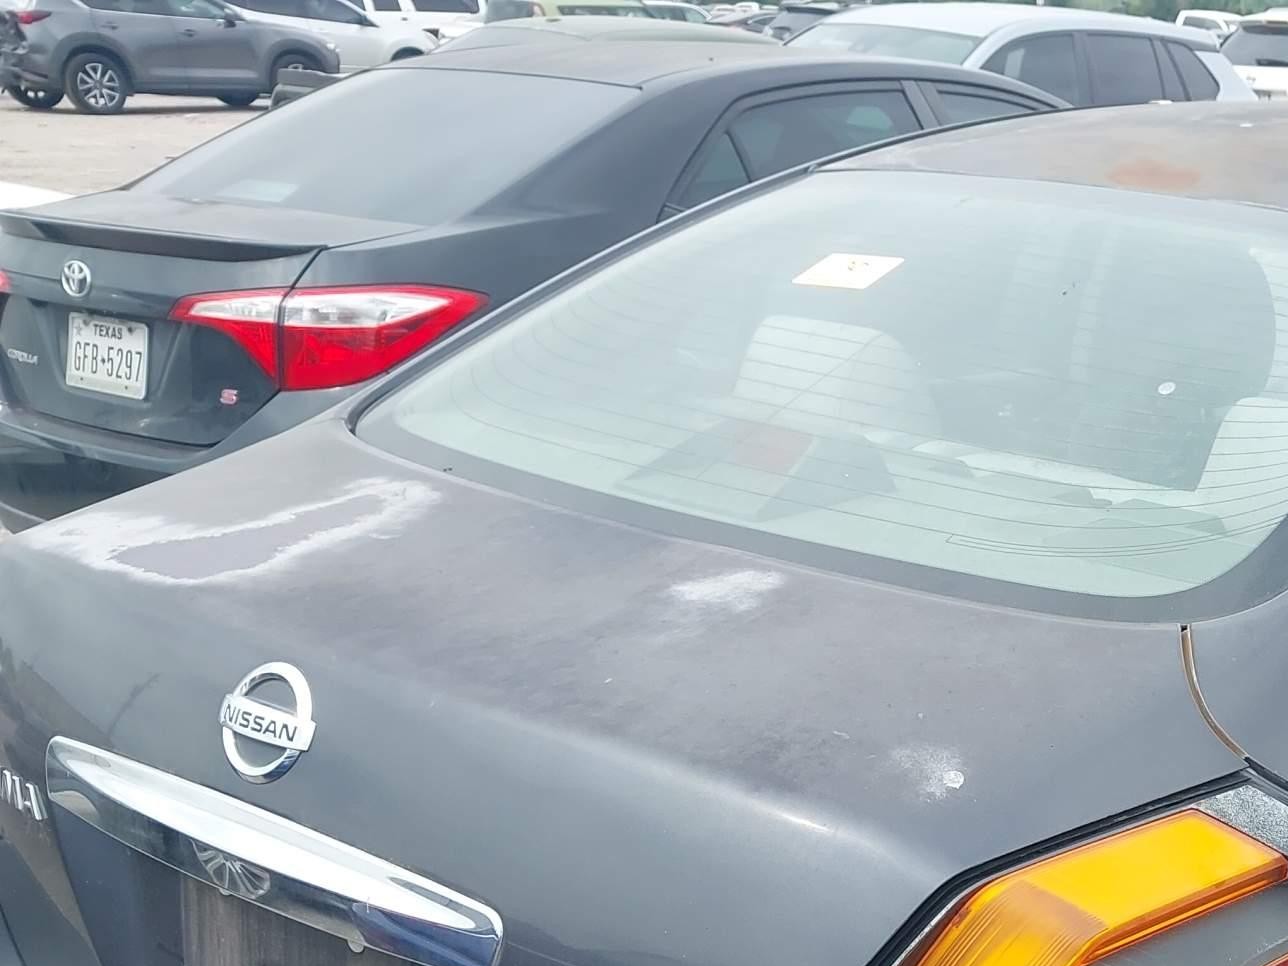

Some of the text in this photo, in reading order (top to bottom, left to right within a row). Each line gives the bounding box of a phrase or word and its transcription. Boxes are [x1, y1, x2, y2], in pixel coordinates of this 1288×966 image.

[93, 323, 123, 340] TEXAS
[220, 388, 238, 405] S
[223, 703, 298, 742] NISSAN
